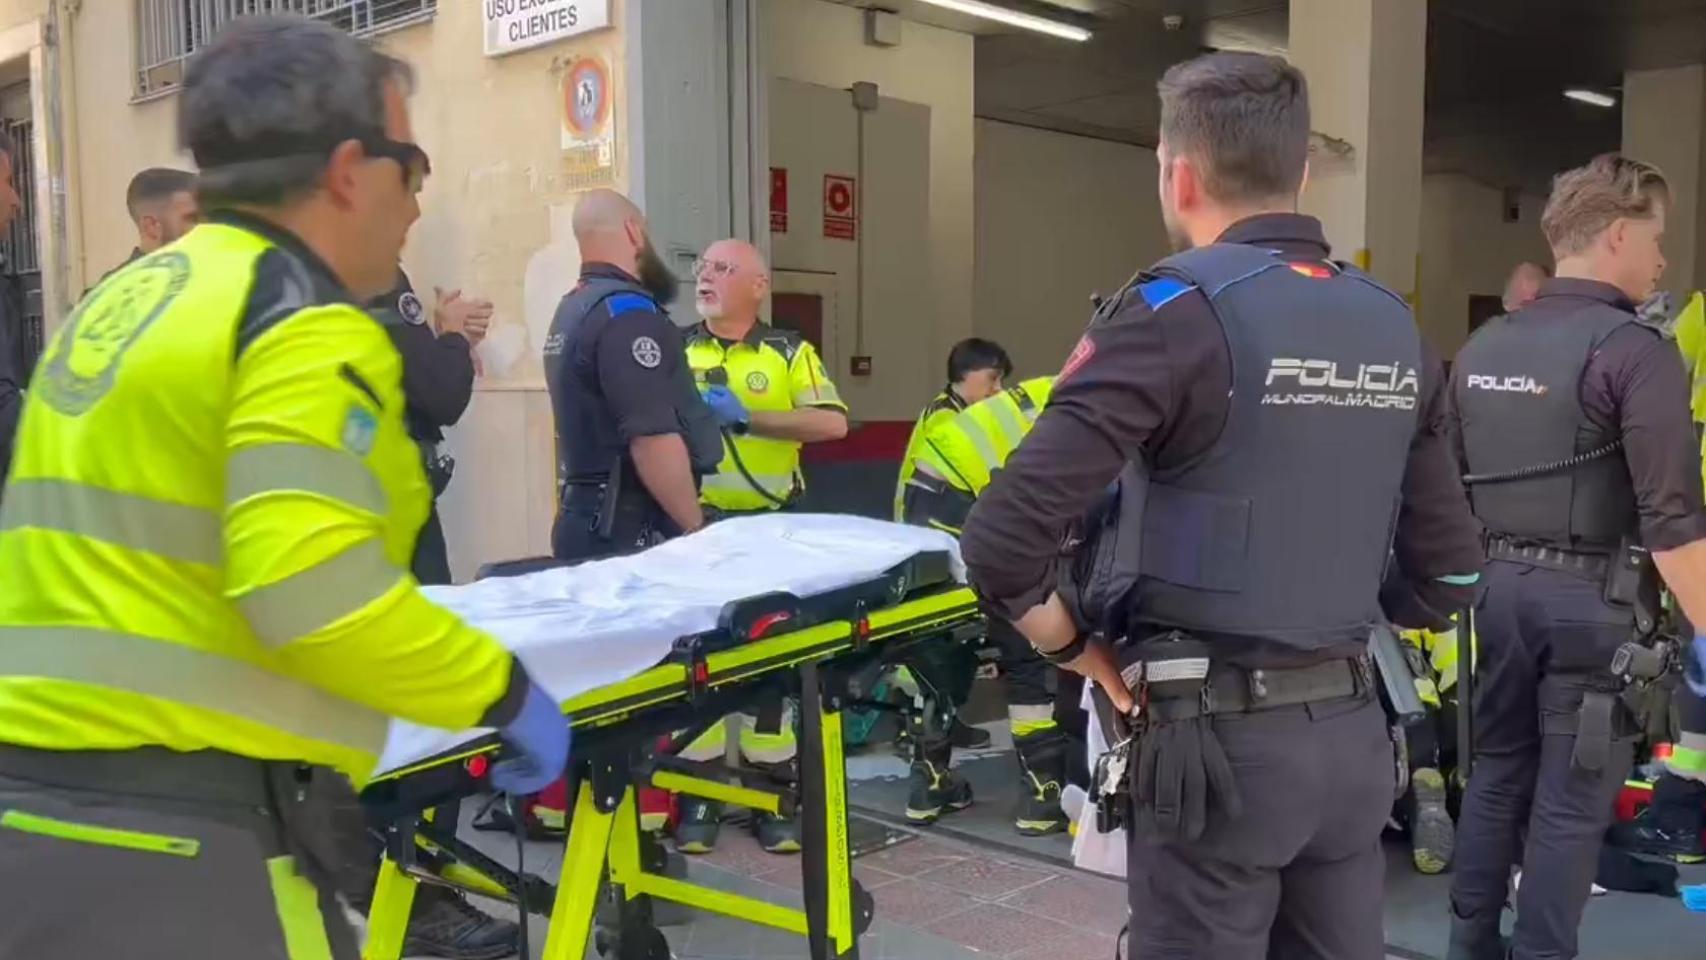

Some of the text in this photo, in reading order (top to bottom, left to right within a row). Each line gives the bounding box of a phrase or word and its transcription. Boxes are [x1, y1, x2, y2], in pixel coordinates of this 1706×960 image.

[486, 0, 515, 20] USO
[508, 5, 578, 42] CLIENTES
[1264, 358, 1419, 393] POLICÍA
[1467, 374, 1537, 394] POLICÍA
[1344, 392, 1417, 411] MADRID
